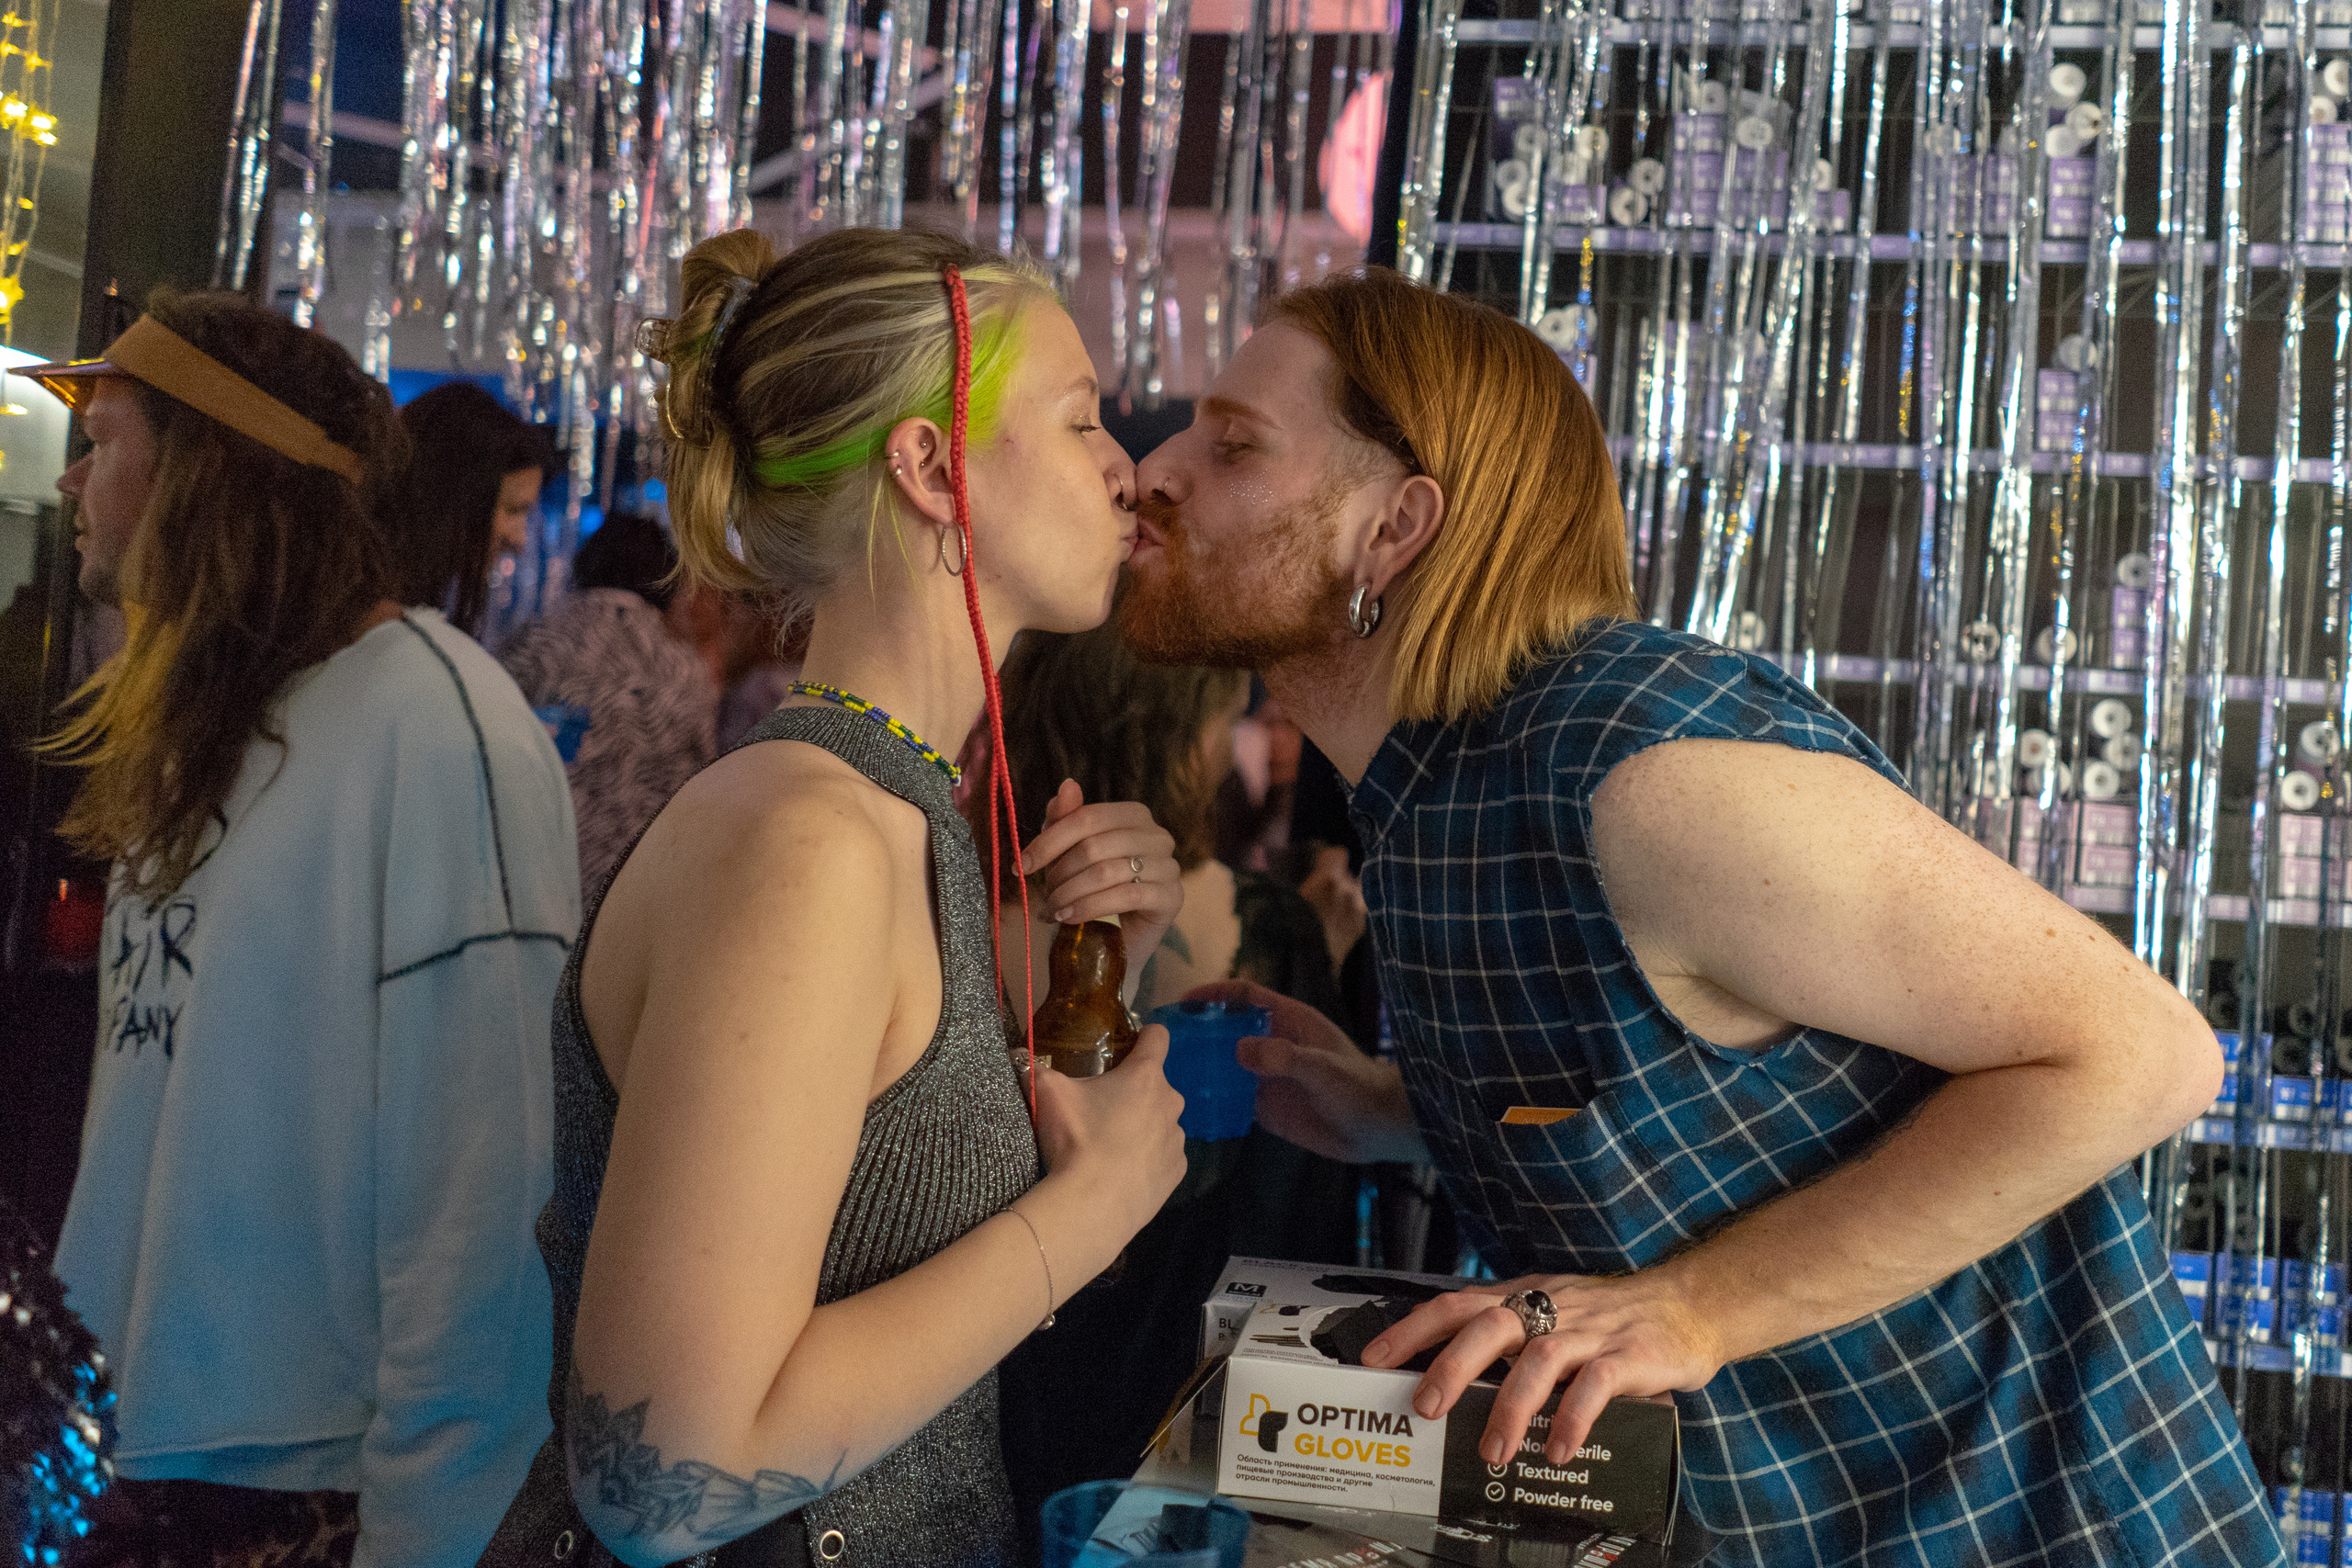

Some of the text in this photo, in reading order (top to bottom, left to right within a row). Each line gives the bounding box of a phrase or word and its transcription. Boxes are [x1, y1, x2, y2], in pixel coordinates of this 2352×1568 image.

[1297, 1403, 1414, 1438] OPTIMA
[1294, 1433, 1411, 1468] GLOVES
[1235, 1472, 1349, 1494] отрасли промышленности.
[1236, 1463, 1275, 1474] пищевые
[1281, 1469, 1335, 1483] производства
[1343, 1476, 1374, 1488] другие
[1237, 1454, 1436, 1487] Область применения: медицина, косметология,
[1516, 1461, 1589, 1484] Textured
[1514, 1487, 1614, 1513] Powder free
